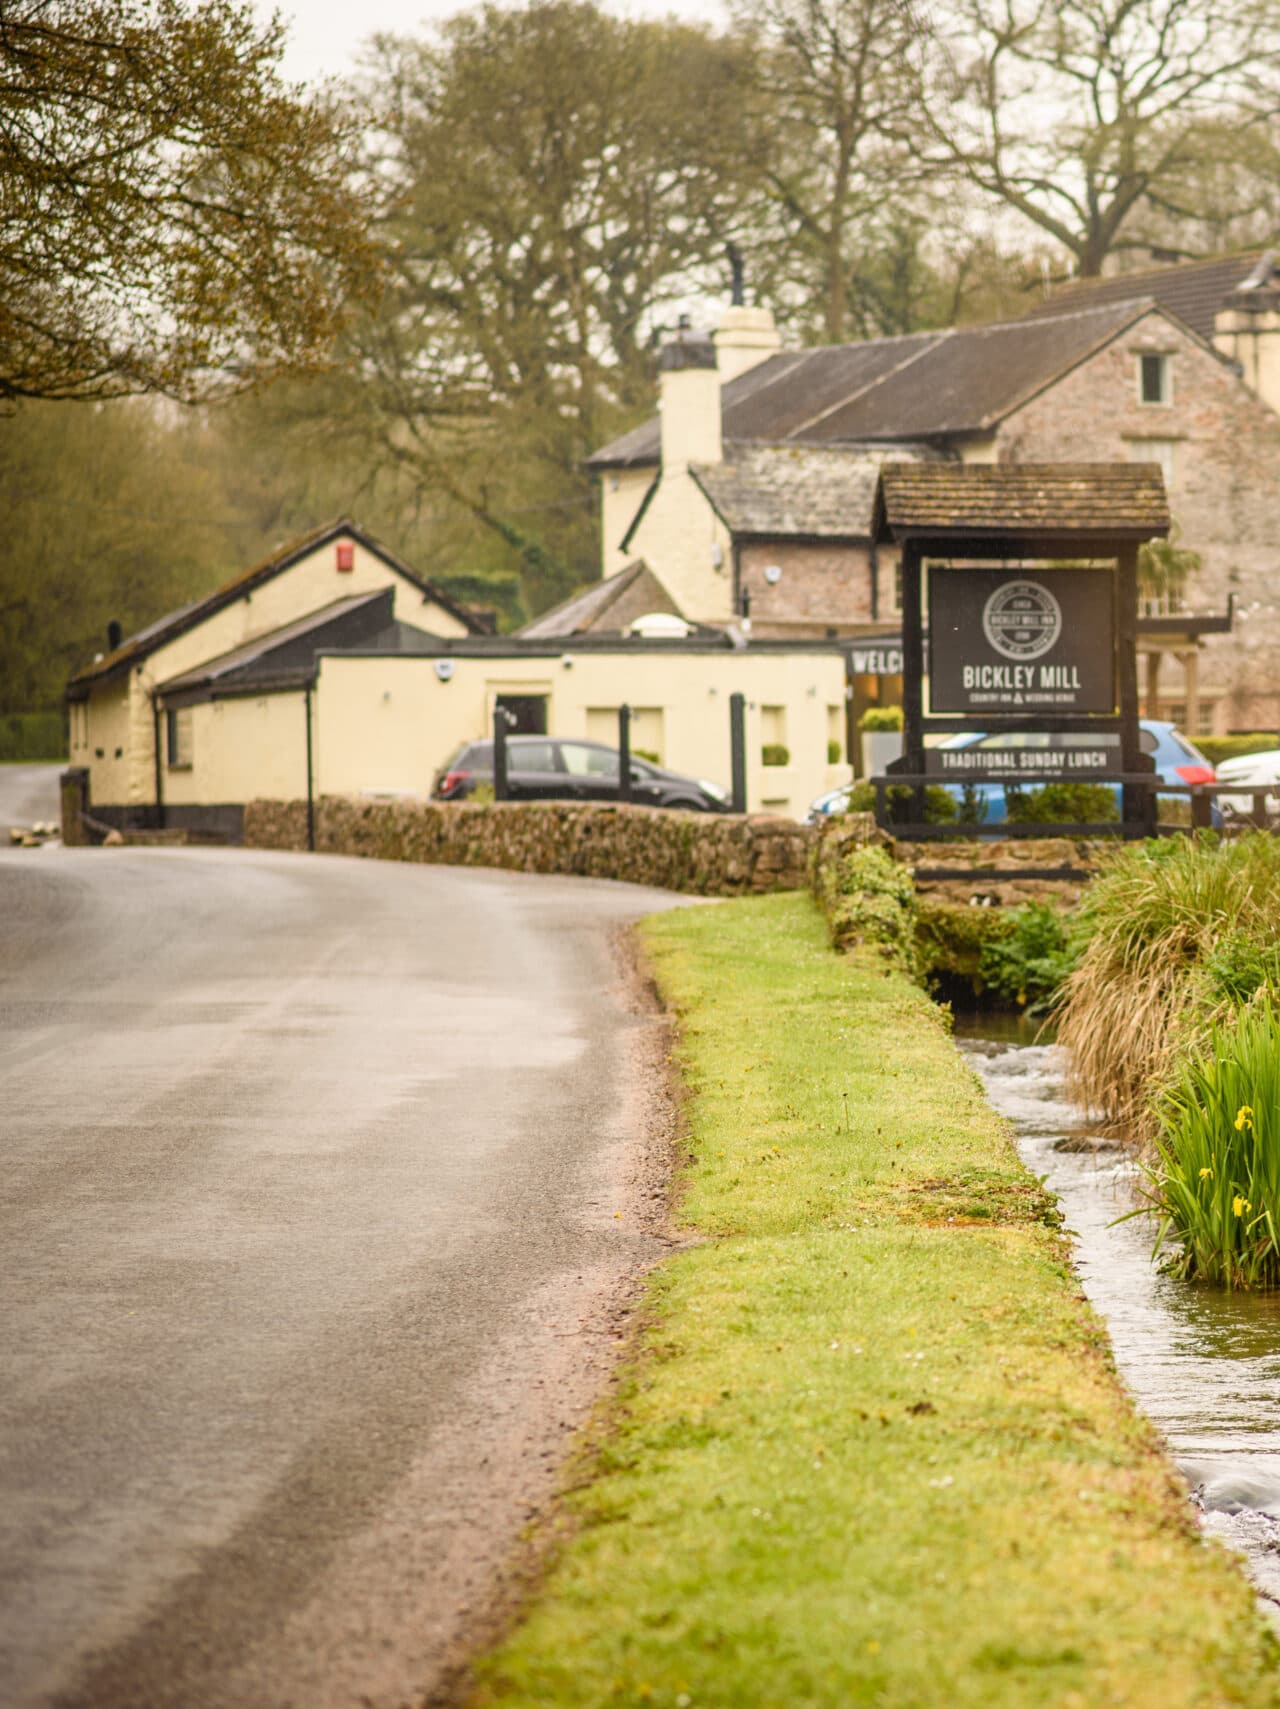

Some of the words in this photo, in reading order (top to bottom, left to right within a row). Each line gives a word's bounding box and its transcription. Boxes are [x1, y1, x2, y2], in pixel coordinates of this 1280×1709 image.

[1021, 615, 1039, 624] MILL
[963, 666, 1035, 689] BICKLEY
[1040, 666, 1081, 689] MILL
[942, 752, 1016, 769] TRADITIONAL
[1019, 752, 1065, 768] SUNDAY
[1068, 752, 1107, 767] LUNCH
